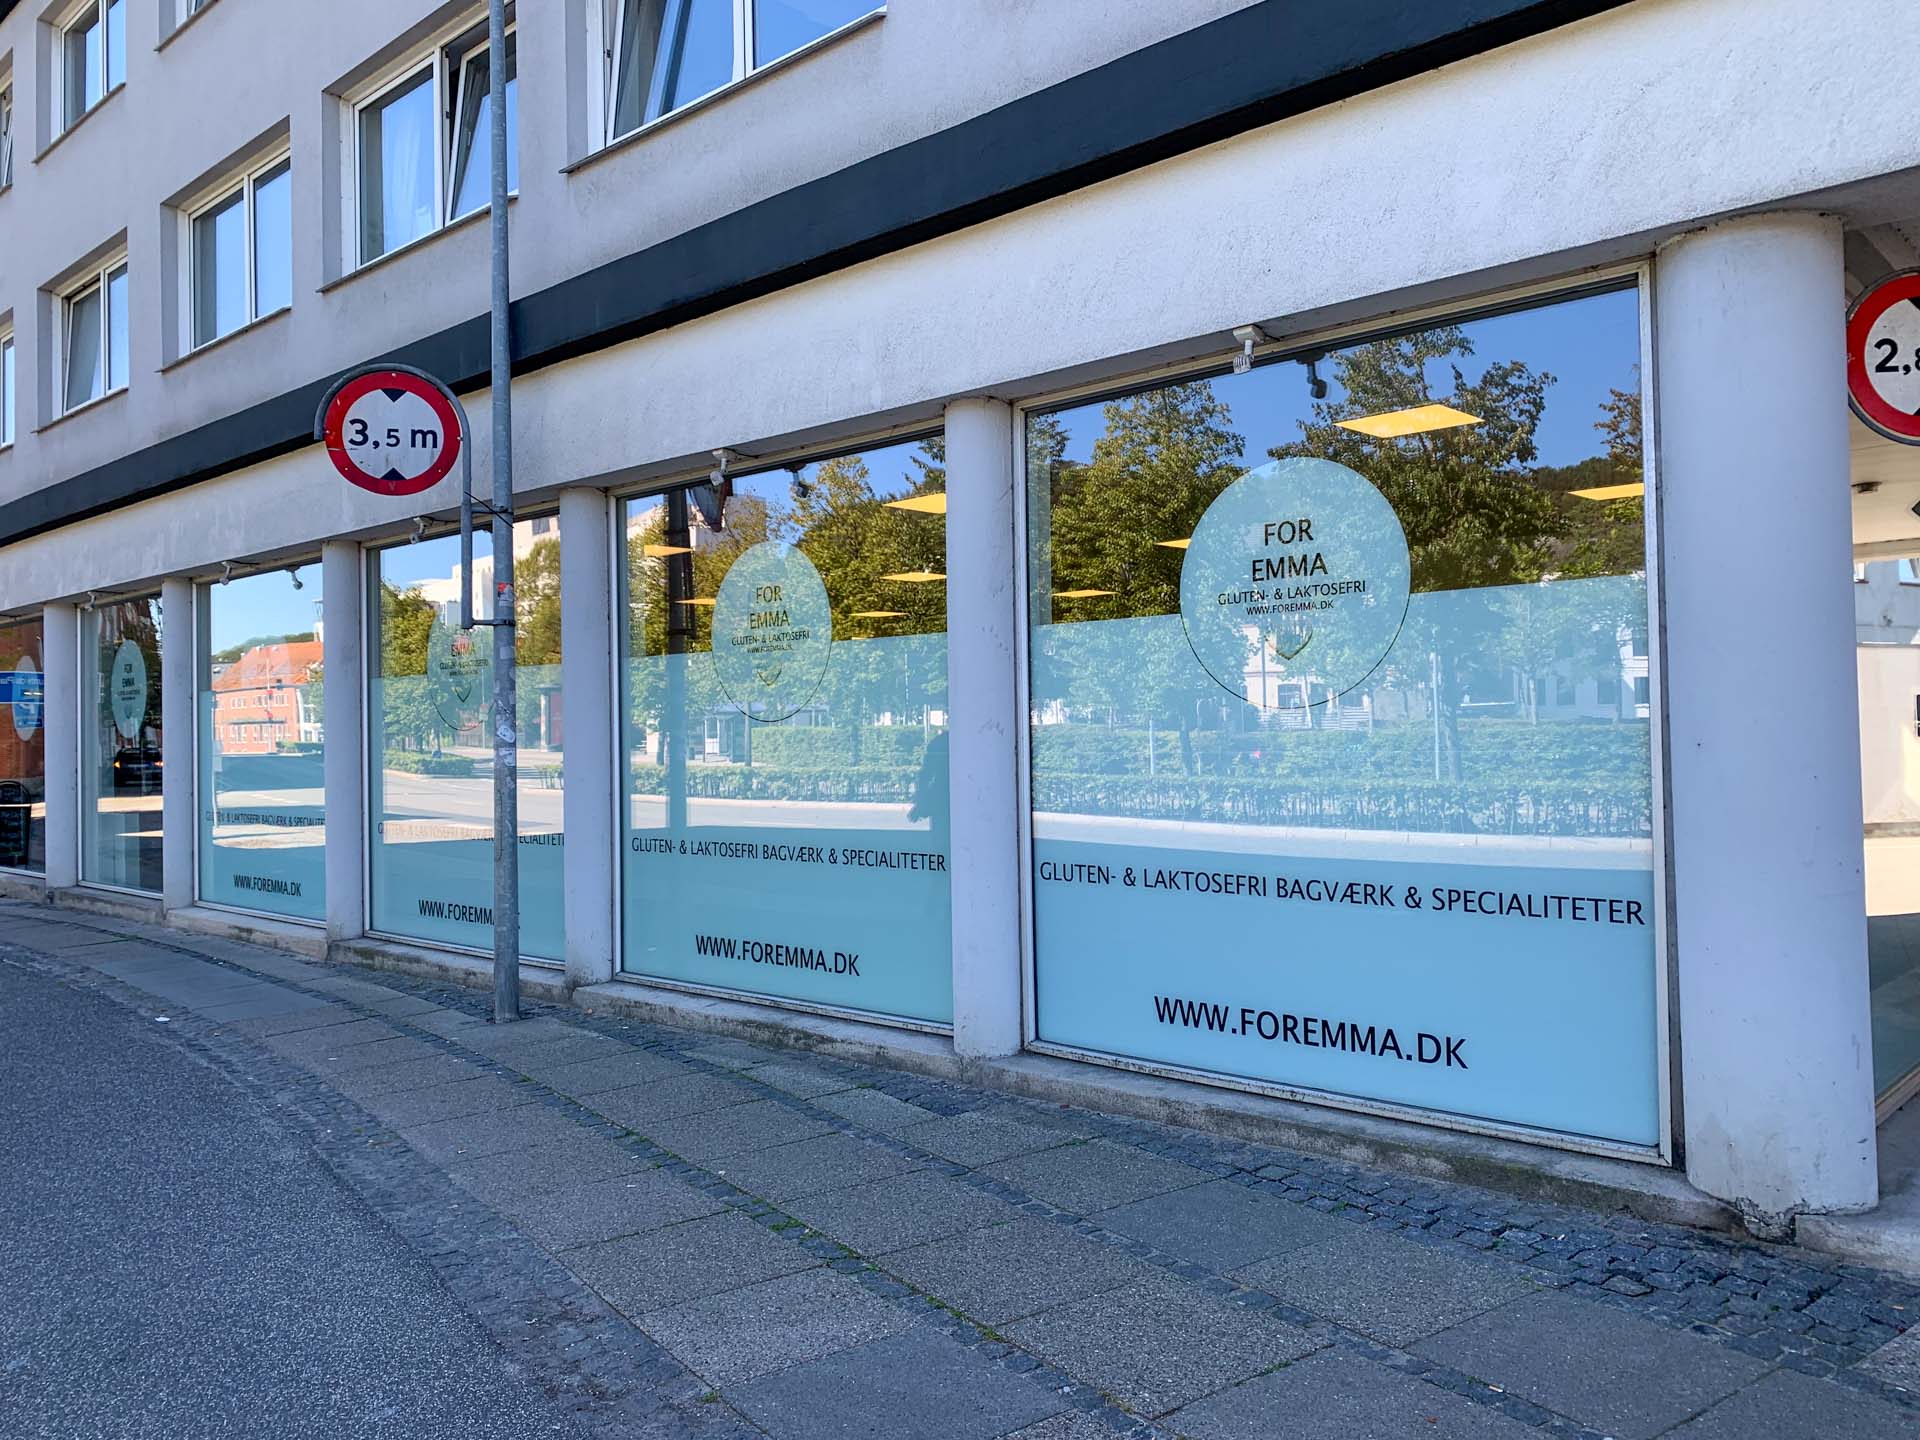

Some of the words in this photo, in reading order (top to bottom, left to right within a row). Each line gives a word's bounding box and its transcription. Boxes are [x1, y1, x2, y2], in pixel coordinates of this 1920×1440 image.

[348, 418, 400, 449] 3,5
[410, 428, 438, 449] m
[1264, 518, 1314, 546] FOR
[1252, 552, 1329, 582] EMMA
[756, 585, 783, 603] FOR
[1218, 590, 1270, 606] GLUTEN-
[1274, 587, 1283, 600] &
[1287, 580, 1366, 599] LAKTOSEFRI
[750, 609, 791, 630] EMMA
[1246, 600, 1334, 616] WWW.FOREMMA.DK
[768, 630, 810, 643] LAKTOSEFRI
[631, 837, 676, 854] GLUTEN-
[679, 840, 687, 855] &
[690, 840, 758, 860] LAKTOSEFRI
[762, 844, 824, 864] BAGVÆRK
[828, 847, 838, 865] &
[842, 848, 946, 872] SPECIALITETER
[233, 873, 302, 897] WWW.FOREMMA.DK
[1040, 861, 1116, 885] GLUTEN-
[1123, 867, 1136, 887] &
[1143, 868, 1267, 897] LAKTOSEFRI
[1276, 878, 1395, 907] BAGVÆRK
[1404, 886, 1422, 909] &
[1431, 887, 1646, 926] SPECIALITETER
[695, 934, 861, 977] WWW.FOREMMA.DK
[1153, 995, 1469, 1069] WWW.FOREMMA.DK
